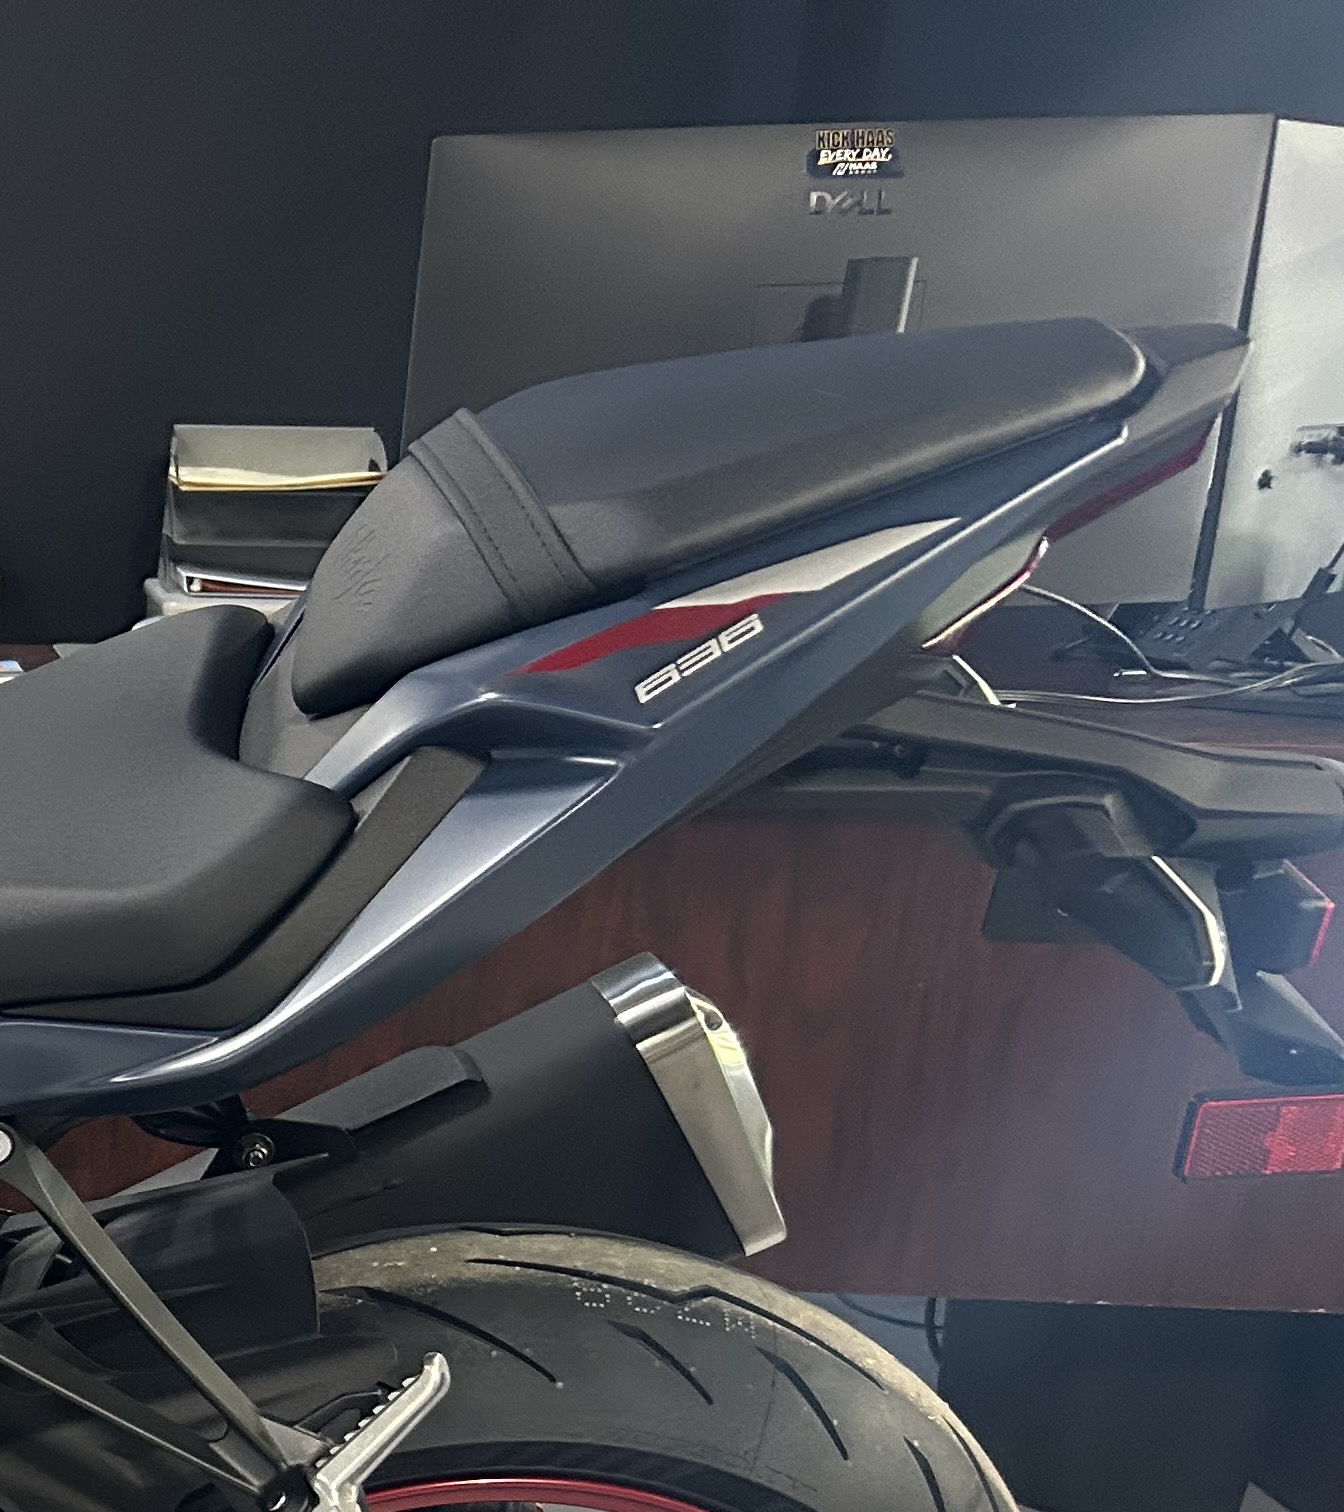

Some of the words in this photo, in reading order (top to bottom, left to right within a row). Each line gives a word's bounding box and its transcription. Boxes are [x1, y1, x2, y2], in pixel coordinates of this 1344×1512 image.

[816, 130, 851, 150] KICK
[853, 128, 895, 148] HAAS
[819, 149, 860, 162] EVERY
[635, 613, 763, 704] 636
